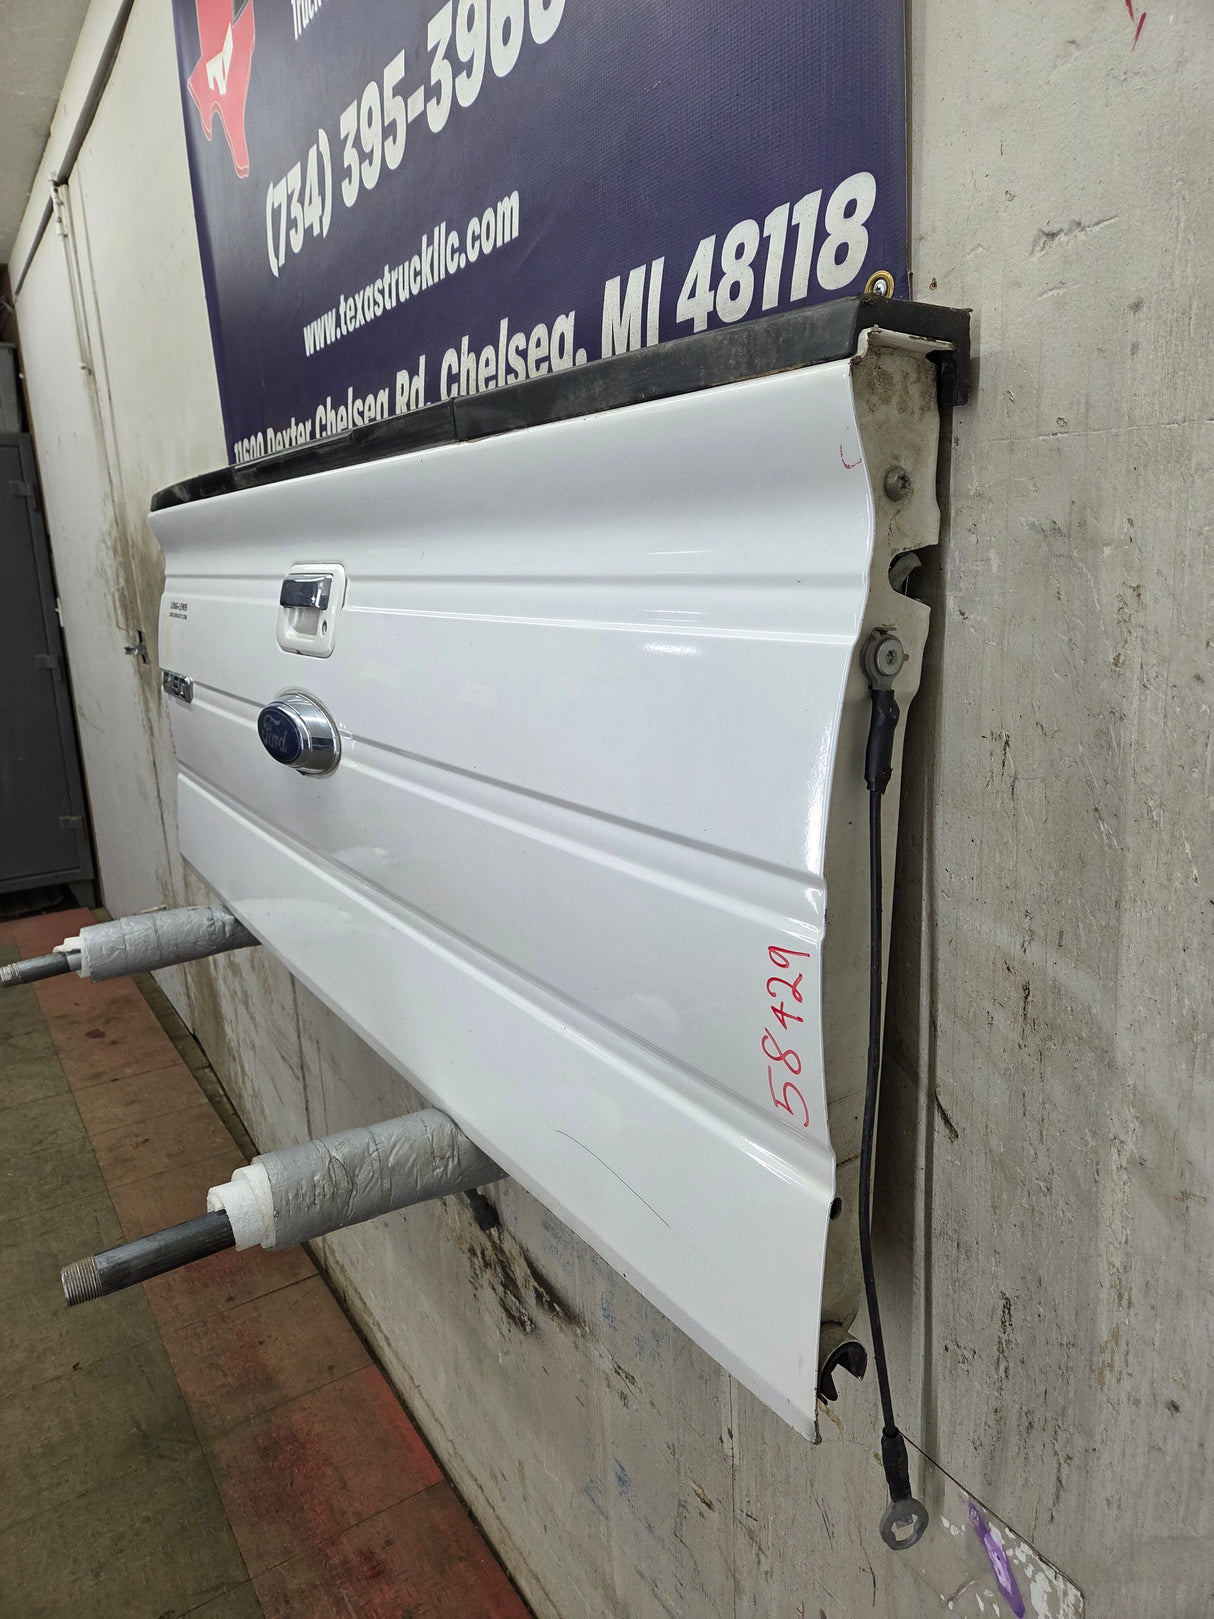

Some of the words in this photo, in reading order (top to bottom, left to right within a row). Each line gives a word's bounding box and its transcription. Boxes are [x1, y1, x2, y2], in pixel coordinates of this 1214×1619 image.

[291, 0, 322, 40] Truc
[266, 128, 332, 278] (734)
[303, 190, 519, 357] www.texastruckllc.com
[315, 386, 389, 439] Chelsea
[601, 256, 665, 359] MI
[676, 171, 877, 333] 48118
[761, 945, 811, 1128] 58429
